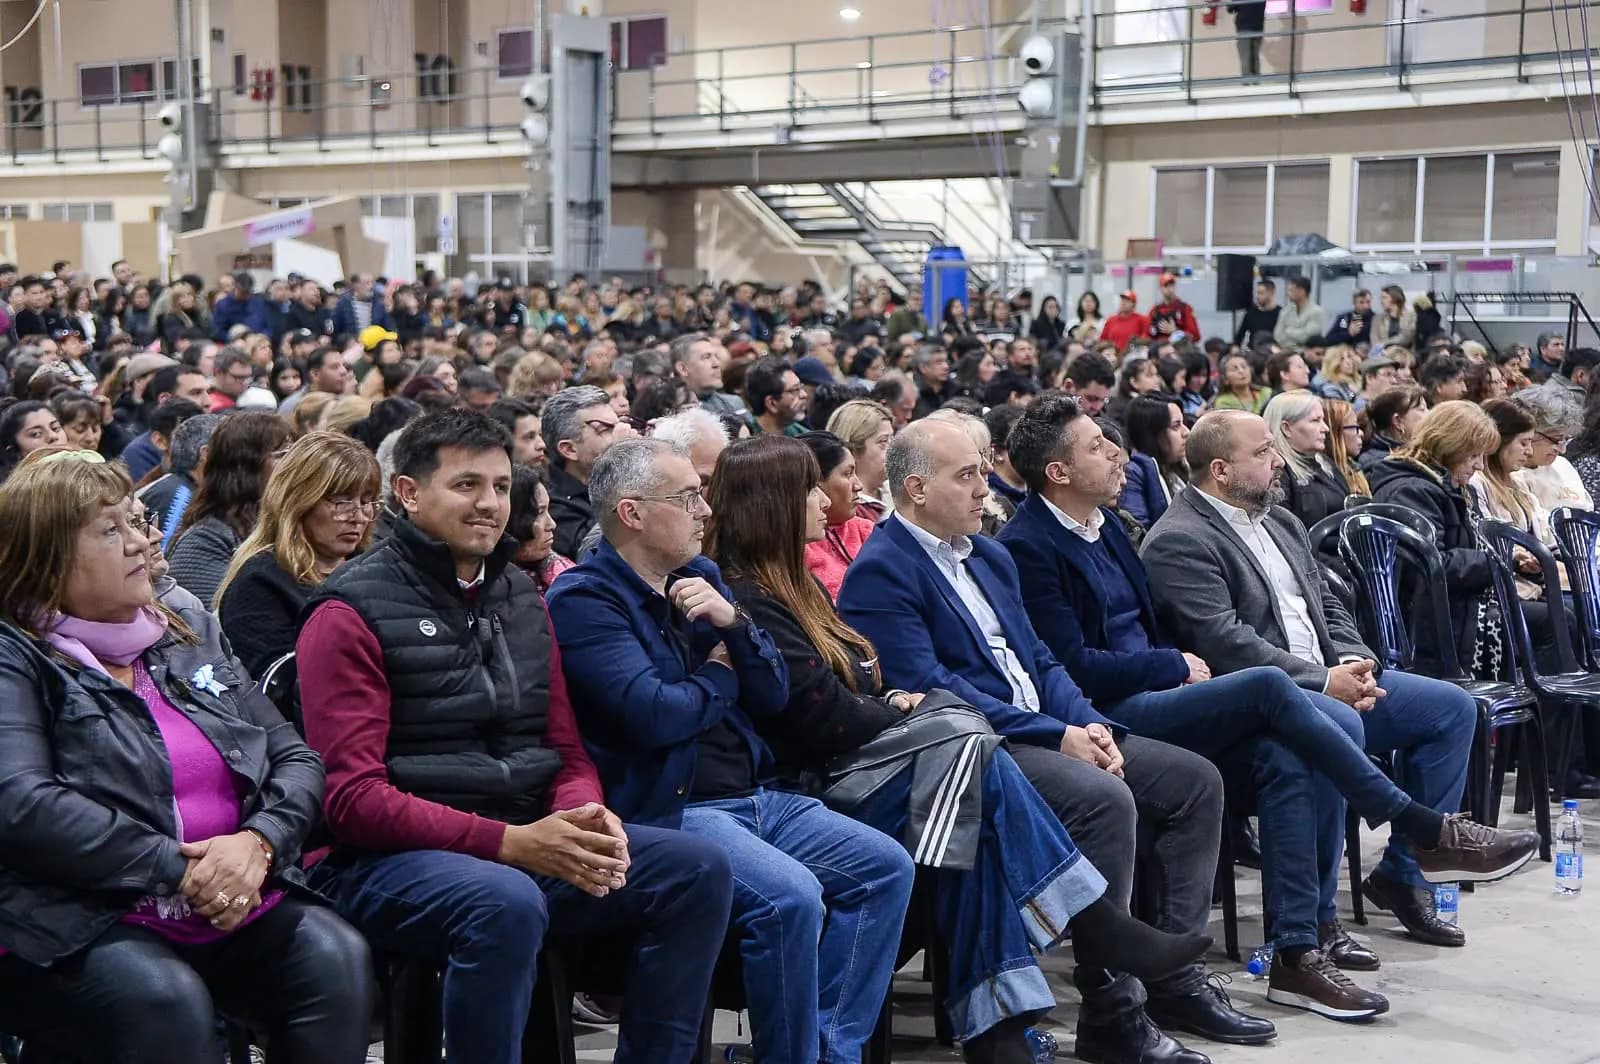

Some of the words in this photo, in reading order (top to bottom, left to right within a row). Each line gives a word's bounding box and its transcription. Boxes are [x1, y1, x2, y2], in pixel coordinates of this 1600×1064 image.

[281, 64, 311, 113] 11
[415, 53, 456, 106] 10
[4, 86, 43, 130] 12
